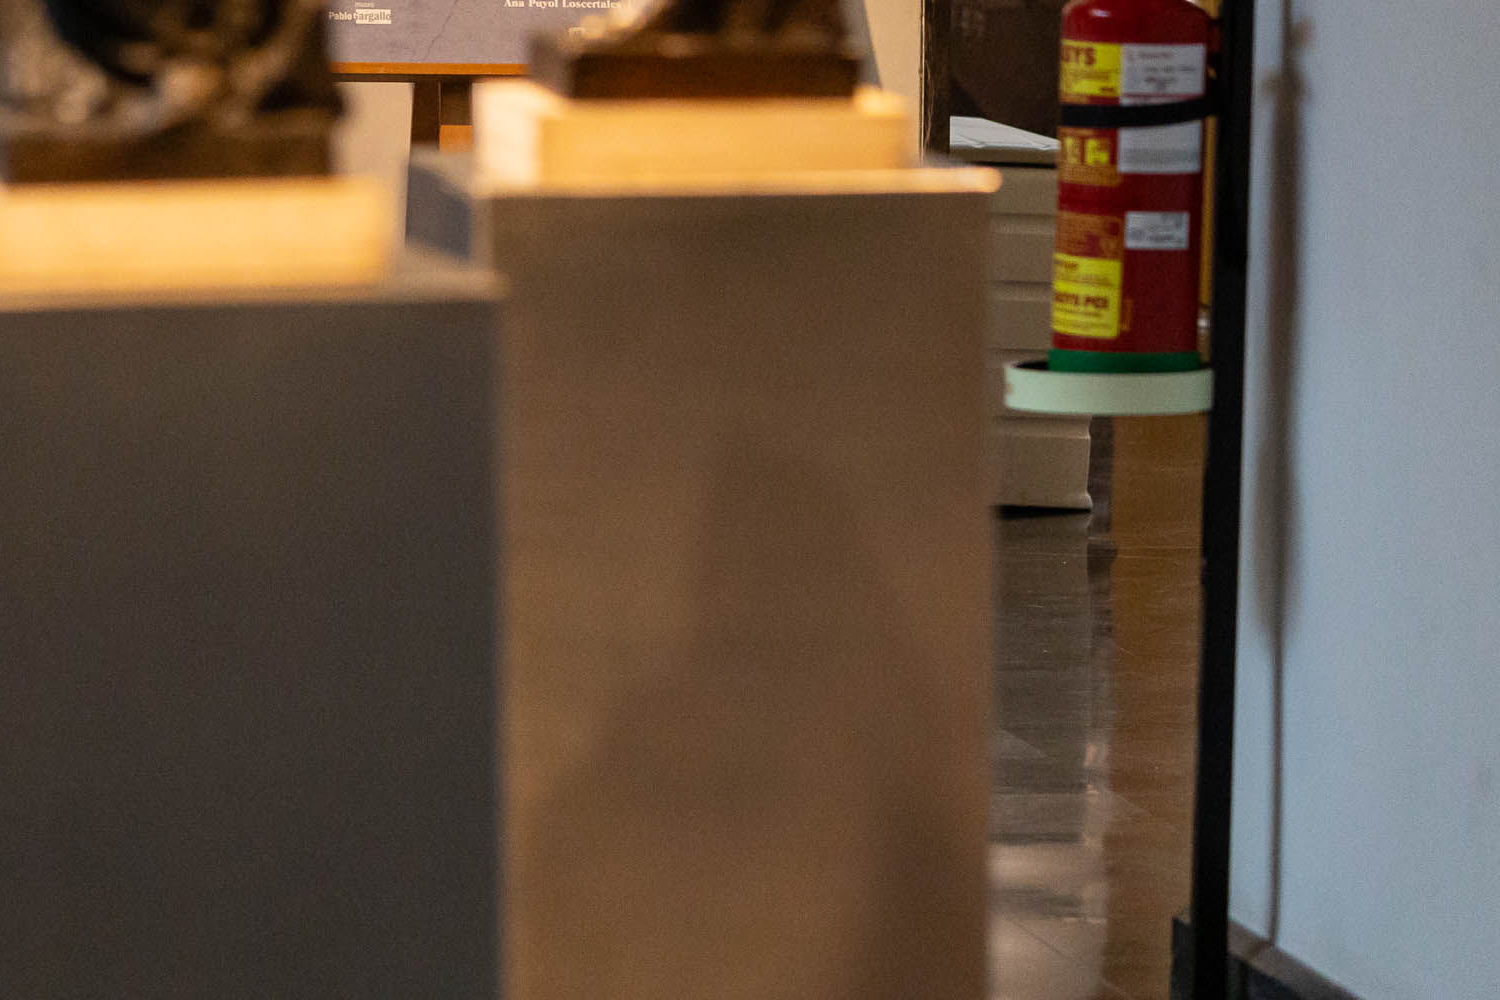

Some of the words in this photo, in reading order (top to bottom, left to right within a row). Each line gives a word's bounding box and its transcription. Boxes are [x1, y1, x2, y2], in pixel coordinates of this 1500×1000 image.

[503, 0, 525, 8] Ana
[528, 0, 559, 10] Puyol
[562, 0, 622, 9] Loscertales
[328, 11, 352, 20] Pablo
